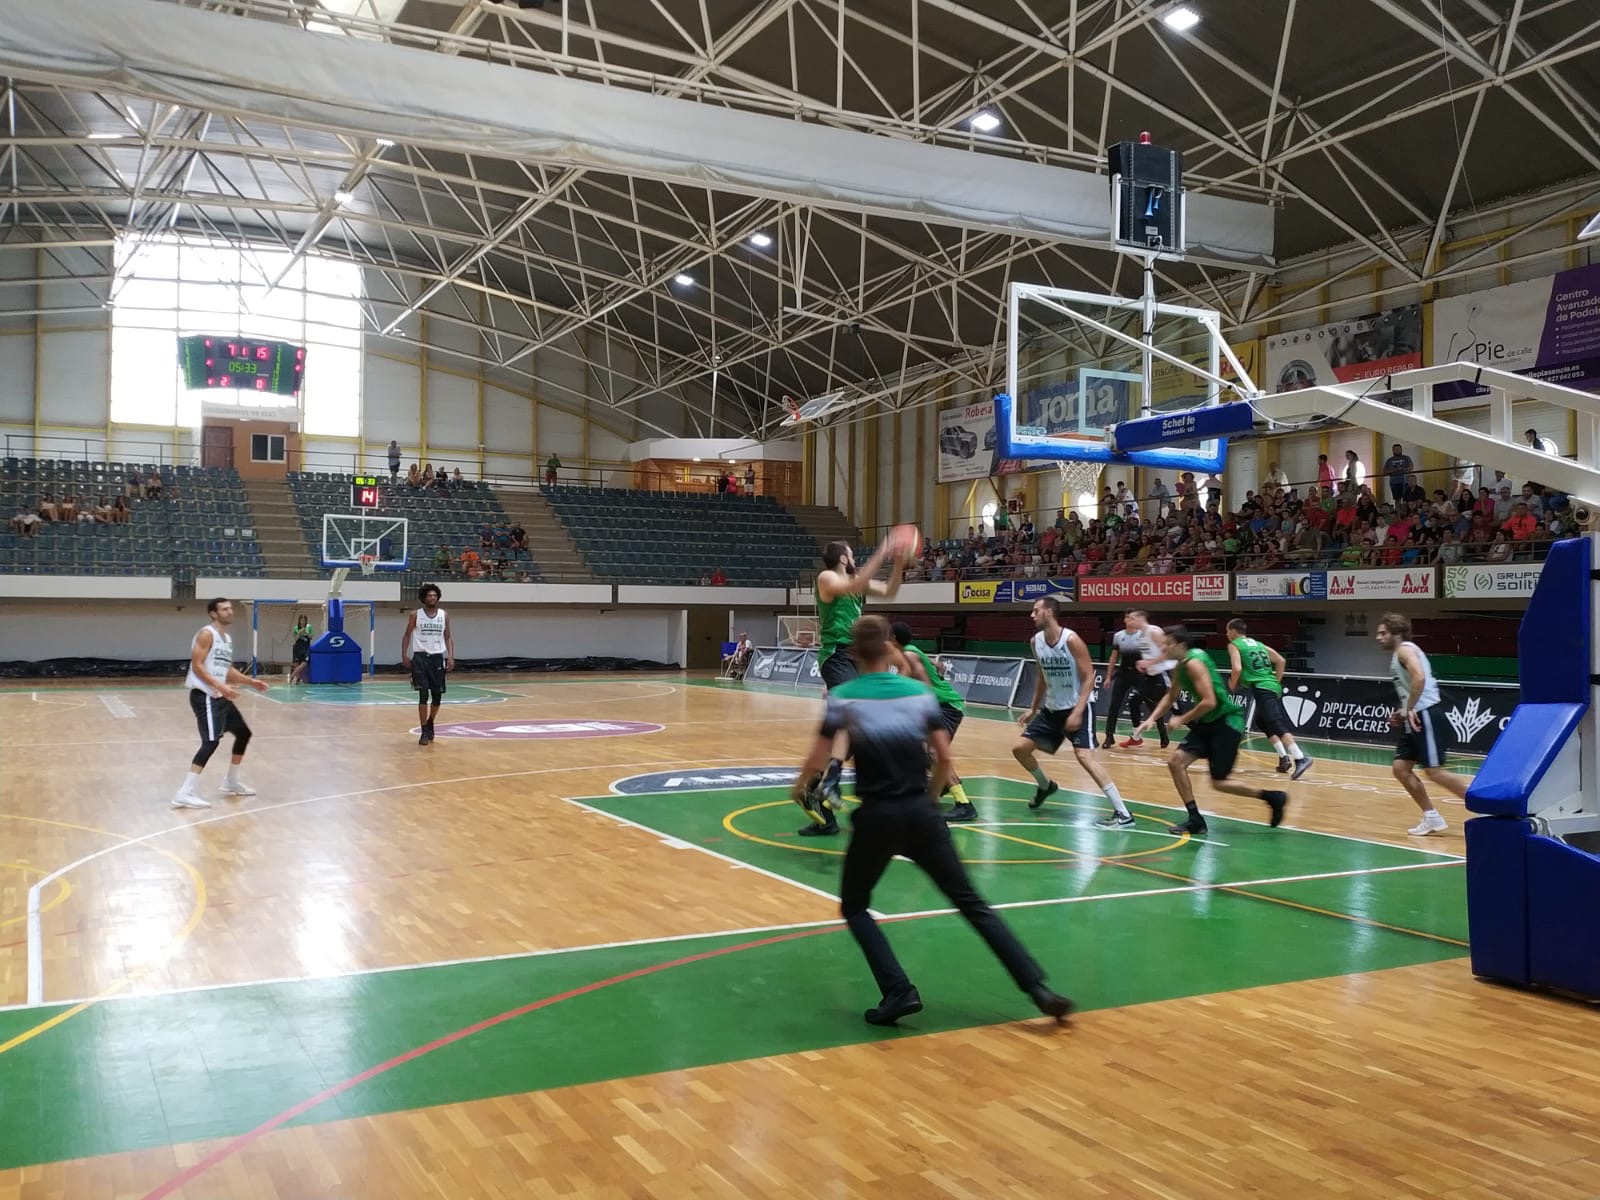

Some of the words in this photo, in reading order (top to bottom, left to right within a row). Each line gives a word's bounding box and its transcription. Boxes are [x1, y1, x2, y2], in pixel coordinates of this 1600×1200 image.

[1555, 289, 1589, 302] Centro
[1555, 313, 1568, 322] de
[1475, 341, 1505, 362] Pie
[229, 361, 257, 374] 05:33
[220, 375, 230, 387] 2
[361, 490, 374, 503] 14
[1497, 571, 1541, 580] GRUPO
[1081, 583, 1129, 597] ENGLISH
[1133, 581, 1191, 596] COLLEGE
[1197, 577, 1223, 588] NLK
[1323, 701, 1394, 718] DIPUTACIÓN
[1319, 715, 1333, 729] DE
[1337, 715, 1391, 733] CÁCERES
